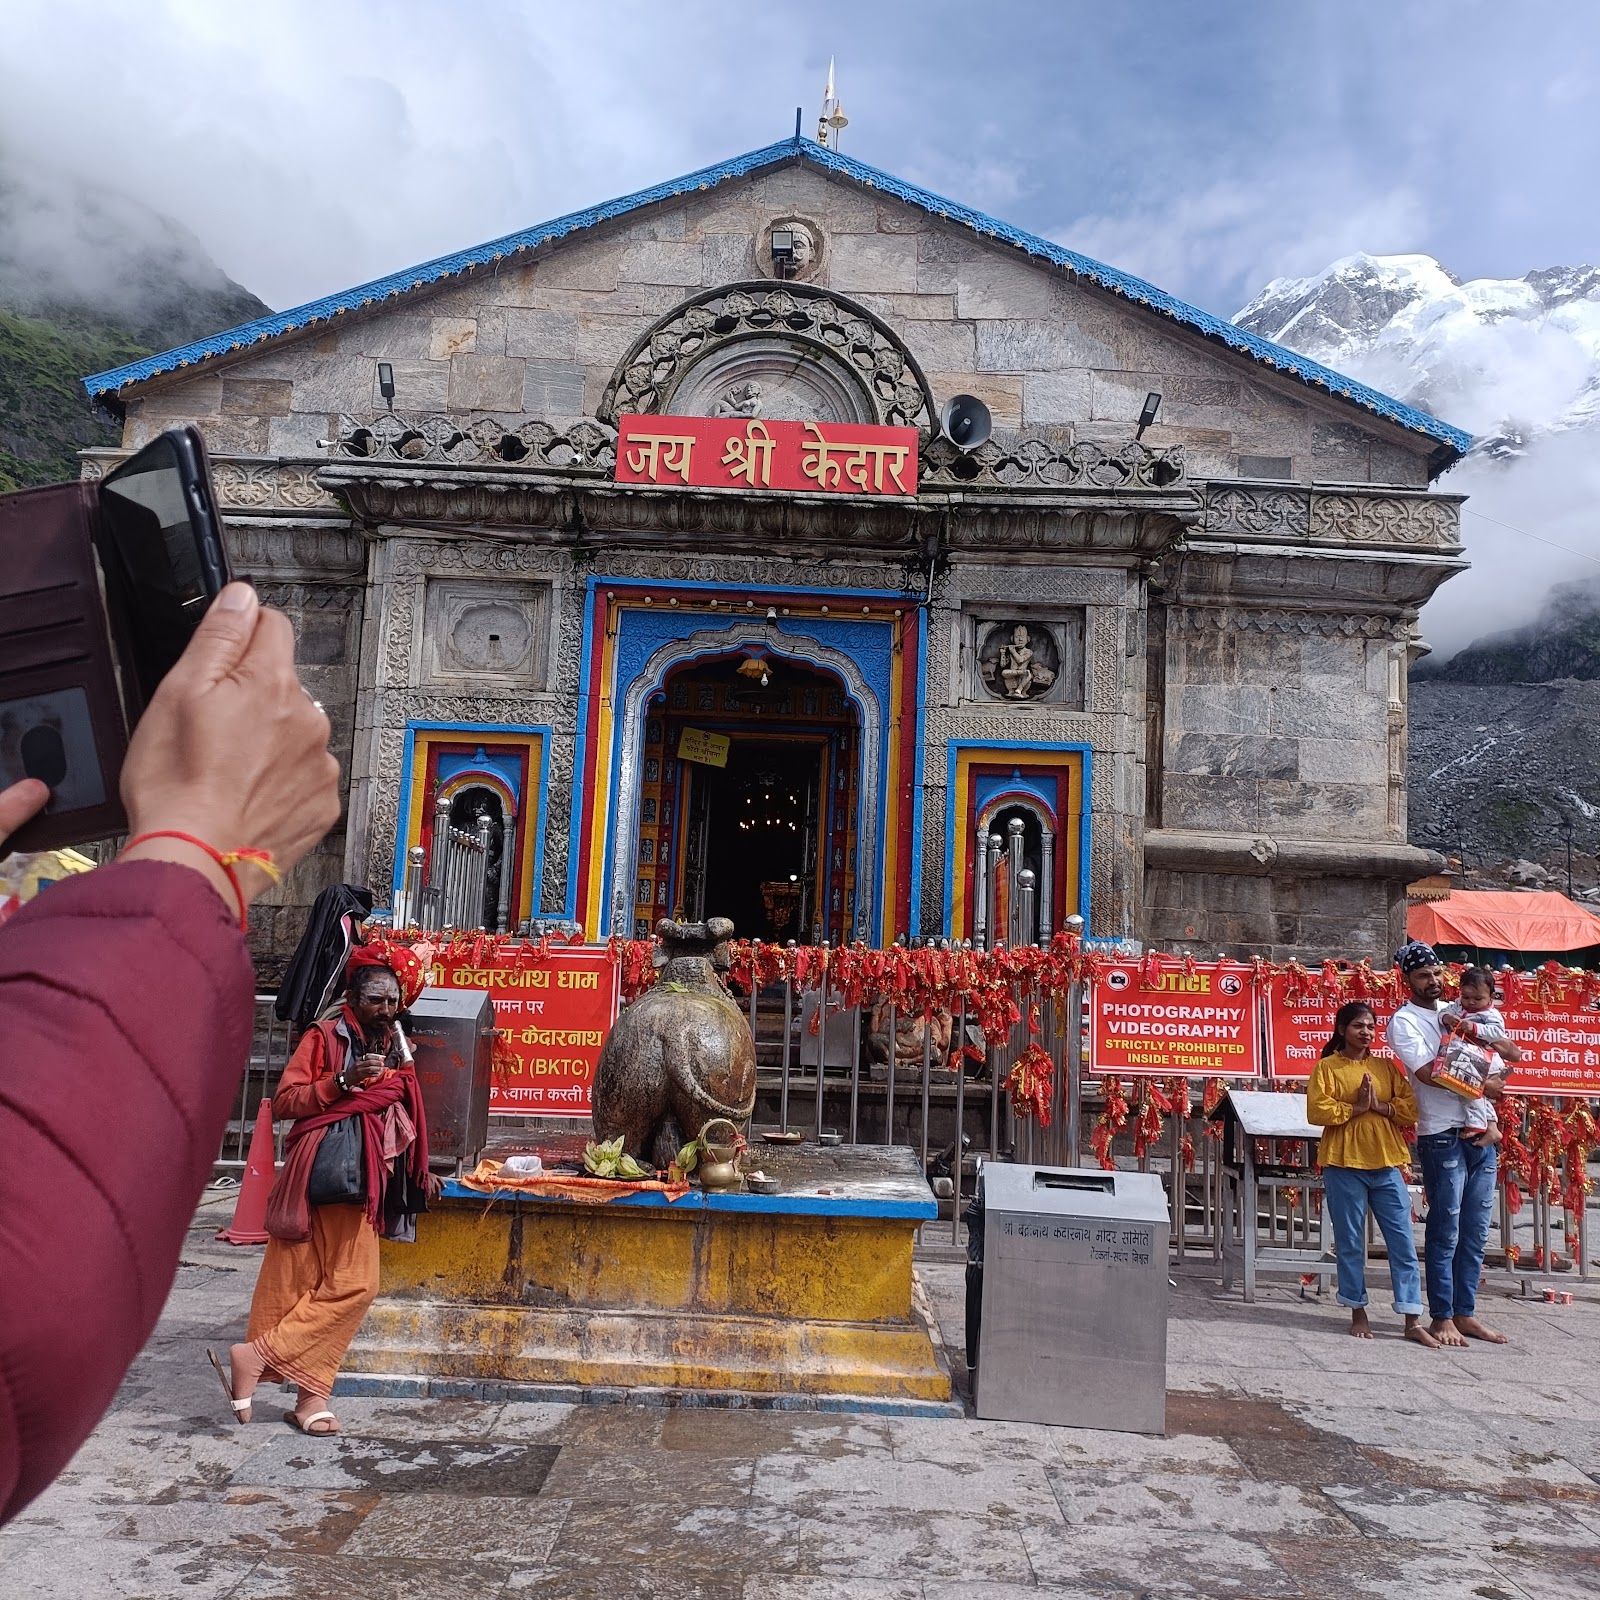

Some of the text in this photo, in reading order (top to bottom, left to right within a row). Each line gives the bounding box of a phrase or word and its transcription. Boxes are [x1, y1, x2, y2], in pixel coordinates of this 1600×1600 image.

[626, 419, 910, 493] जय श्री केदार
[452, 962, 552, 989] केदारनाथ
[557, 969, 600, 990] धाम
[1139, 973, 1211, 992] OTICE
[491, 999, 545, 1015] गमन पर
[1102, 1003, 1246, 1022] PHOTOGRAPHY/
[1291, 1014, 1322, 1026] अपना
[1509, 1010, 1519, 1021] के
[1572, 1015, 1596, 1024] प्रकार
[1108, 1021, 1241, 1038] VIDEOGRAPHY
[1298, 1030, 1334, 1043] दानपा
[1105, 1039, 1245, 1054] STRICTLY PROHIBITED
[1285, 1045, 1317, 1059] किसी
[1127, 1053, 1223, 1067] INSIDE TEMPLE
[1541, 1047, 1581, 1065] वर्जित
[1583, 1049, 1599, 1066] है।
[529, 1057, 590, 1081] (BKTC)
[1513, 1067, 1523, 1076] पर
[1525, 1067, 1549, 1079] कानूनी
[1551, 1068, 1582, 1079] कार्यवाही
[1583, 1069, 1594, 1079] की
[547, 1084, 584, 1103] करती
